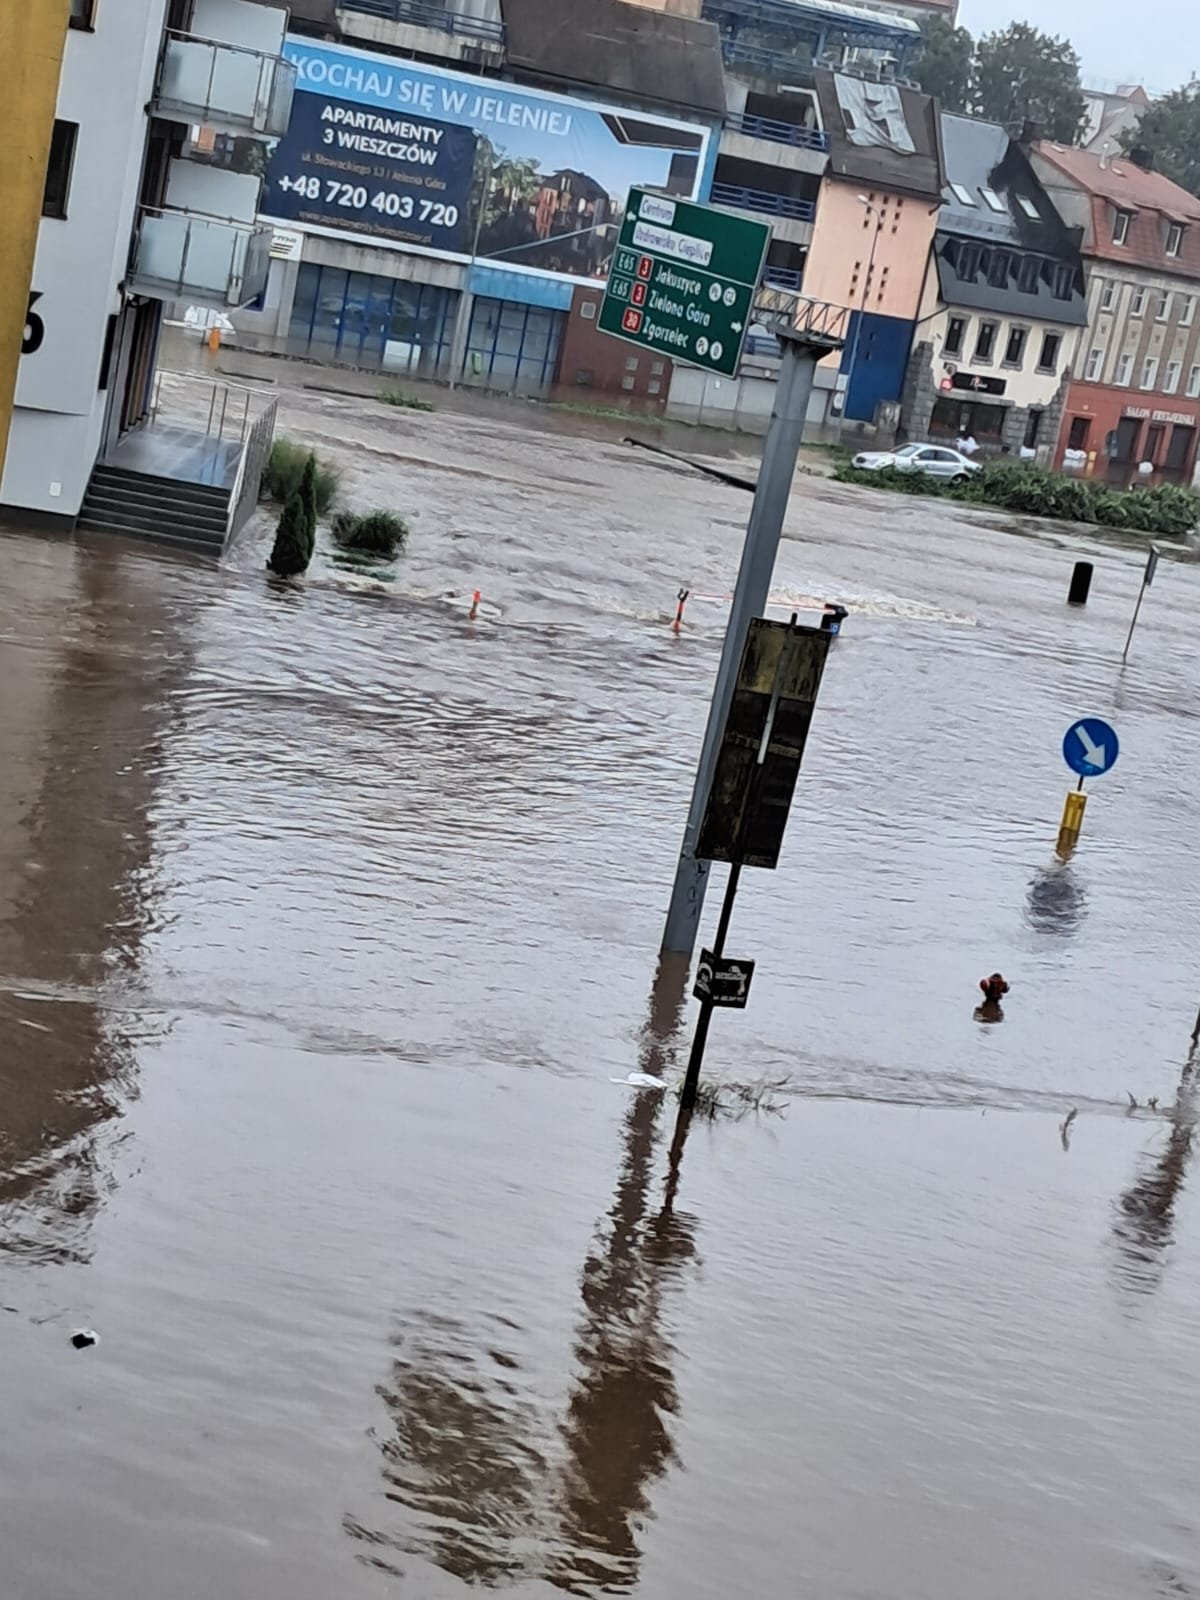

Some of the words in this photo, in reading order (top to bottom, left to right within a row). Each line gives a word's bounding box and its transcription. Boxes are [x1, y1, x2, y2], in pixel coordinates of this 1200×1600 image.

[320, 105, 443, 145] APARTAMENTY
[397, 79, 435, 113] SIĘ
[441, 87, 467, 114] W
[469, 95, 572, 137] JELENIEJ
[323, 128, 334, 144] 3
[337, 130, 438, 166] WIESZCZÓW
[278, 175, 320, 200] +48
[325, 181, 367, 209] 720
[371, 191, 414, 218] 403
[418, 200, 458, 227] 720
[618, 253, 635, 270] E65
[641, 259, 649, 276] 3
[655, 265, 701, 296] Jakuszyce
[612, 280, 629, 297] E65
[636, 286, 643, 302] 3
[648, 290, 684, 318] Zielona
[686, 302, 711, 327] Góra
[642, 316, 689, 348] Zgorzelec
